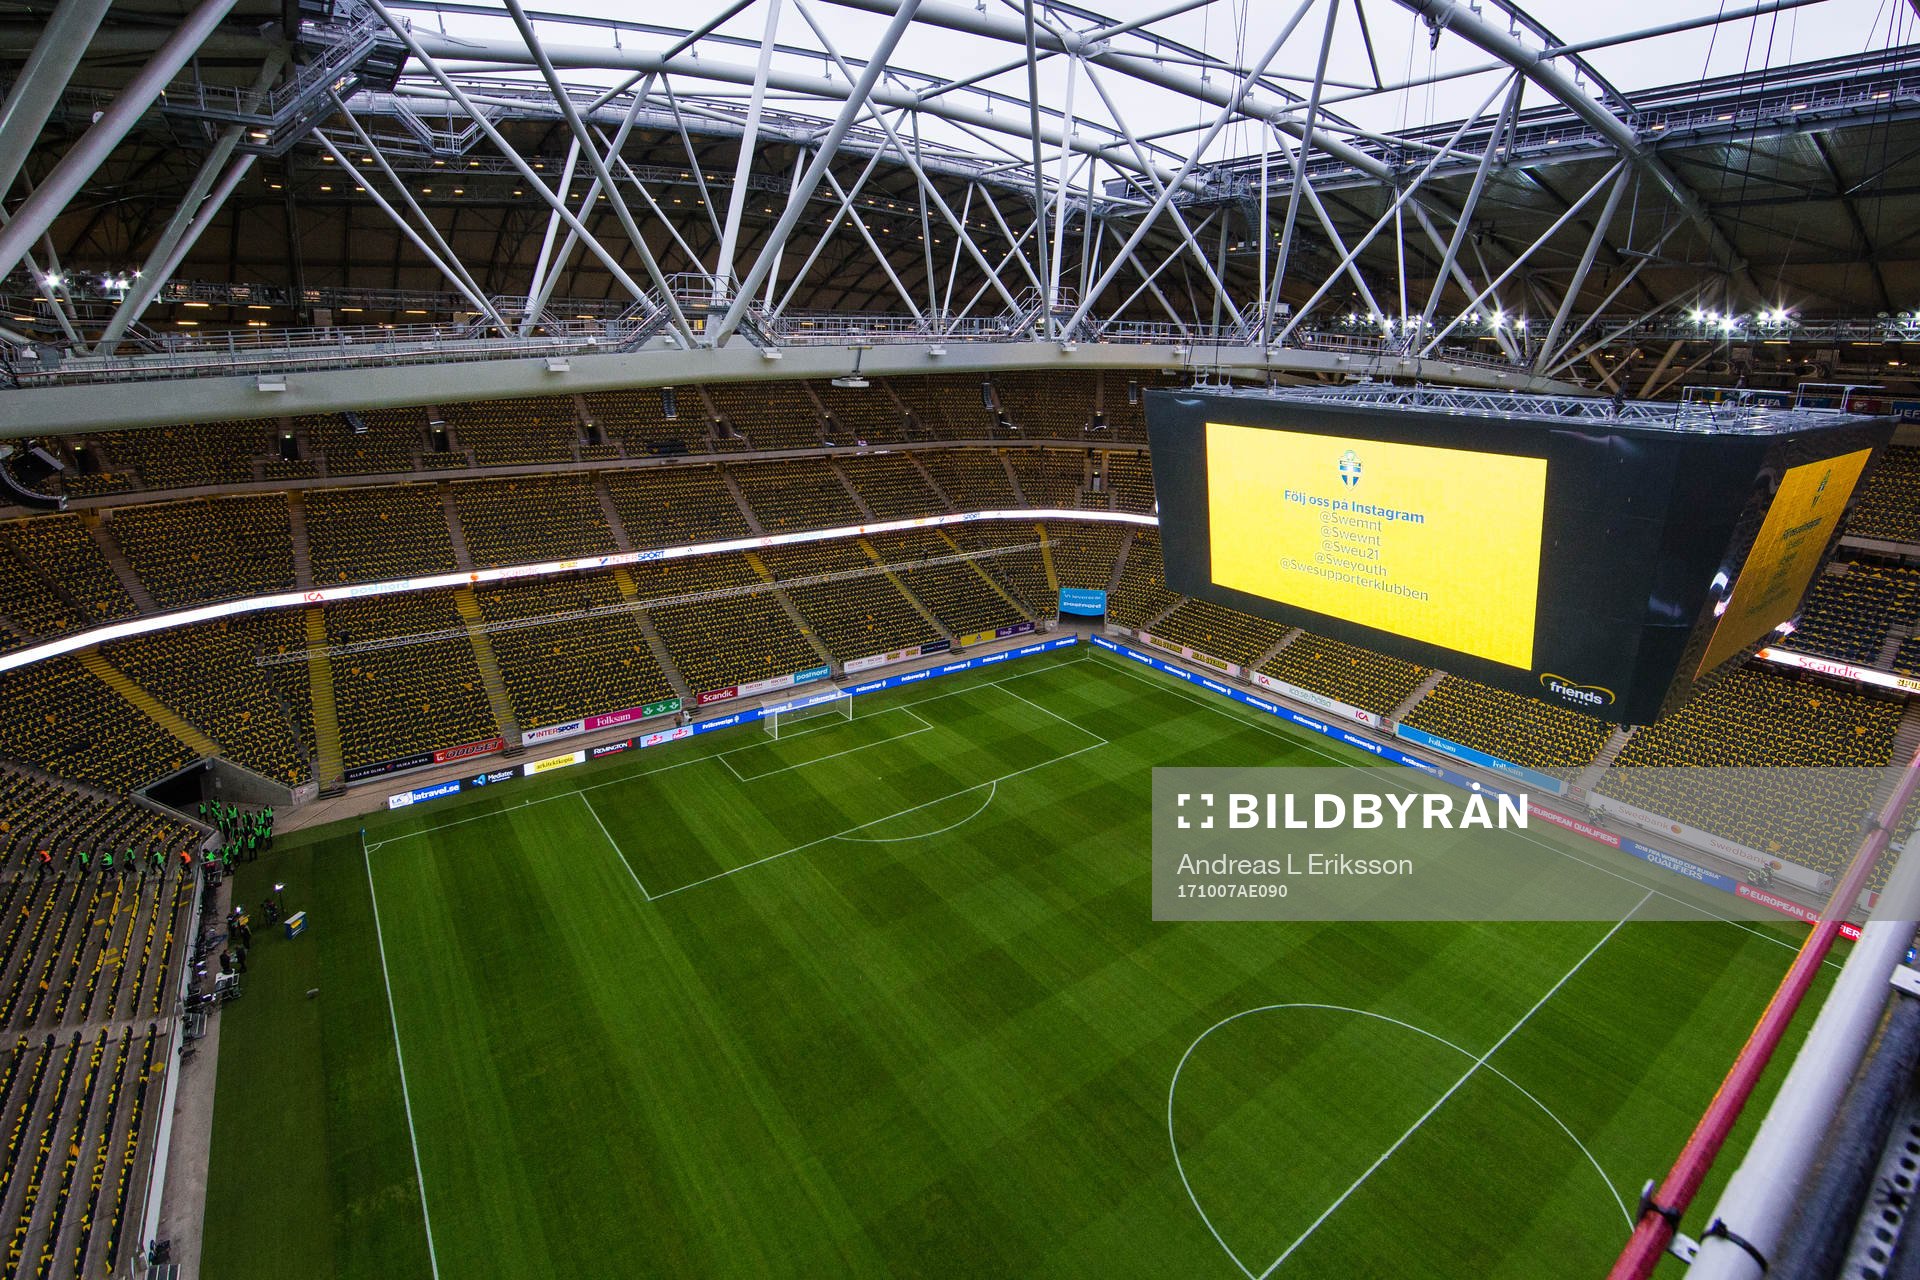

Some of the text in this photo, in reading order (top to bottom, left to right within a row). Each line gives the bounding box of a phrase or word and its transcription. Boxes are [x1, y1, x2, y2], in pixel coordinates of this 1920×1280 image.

[1894, 409, 1920, 417] UEF
[1284, 489, 1425, 524] Följ oss på Instagram
[1319, 511, 1382, 533] @Swemnt
[1320, 525, 1382, 547] @Swewnt
[1321, 539, 1380, 561] @Sweu21
[1314, 551, 1388, 577] @Sweyouth
[1279, 557, 1429, 601] @Swesupporterklubben
[303, 592, 324, 602] ICA
[796, 667, 829, 682] postnord
[1799, 657, 1863, 680] Scandic
[1258, 674, 1271, 686] ICA
[702, 690, 733, 703] Scandic
[1549, 680, 1603, 705] friends
[597, 713, 631, 727] Folksam
[1355, 710, 1369, 722] ICA
[535, 723, 580, 739] INTERSPORT
[445, 740, 499, 760] ODDSET
[593, 742, 628, 755] REMINGTON
[1427, 736, 1456, 753] Folksam
[487, 770, 514, 781] Mediatec
[1492, 760, 1524, 777] Folksam
[1533, 808, 1618, 845] EUROPEAN QUALIFIERS
[1617, 805, 1670, 831] Swedbank
[1660, 852, 1684, 866] WORLD
[1684, 862, 1697, 871] CUP
[1709, 838, 1767, 865] Swedbank
[1647, 853, 1703, 881] QUALIFIERS
[1750, 890, 1804, 917] EUROPEAN
